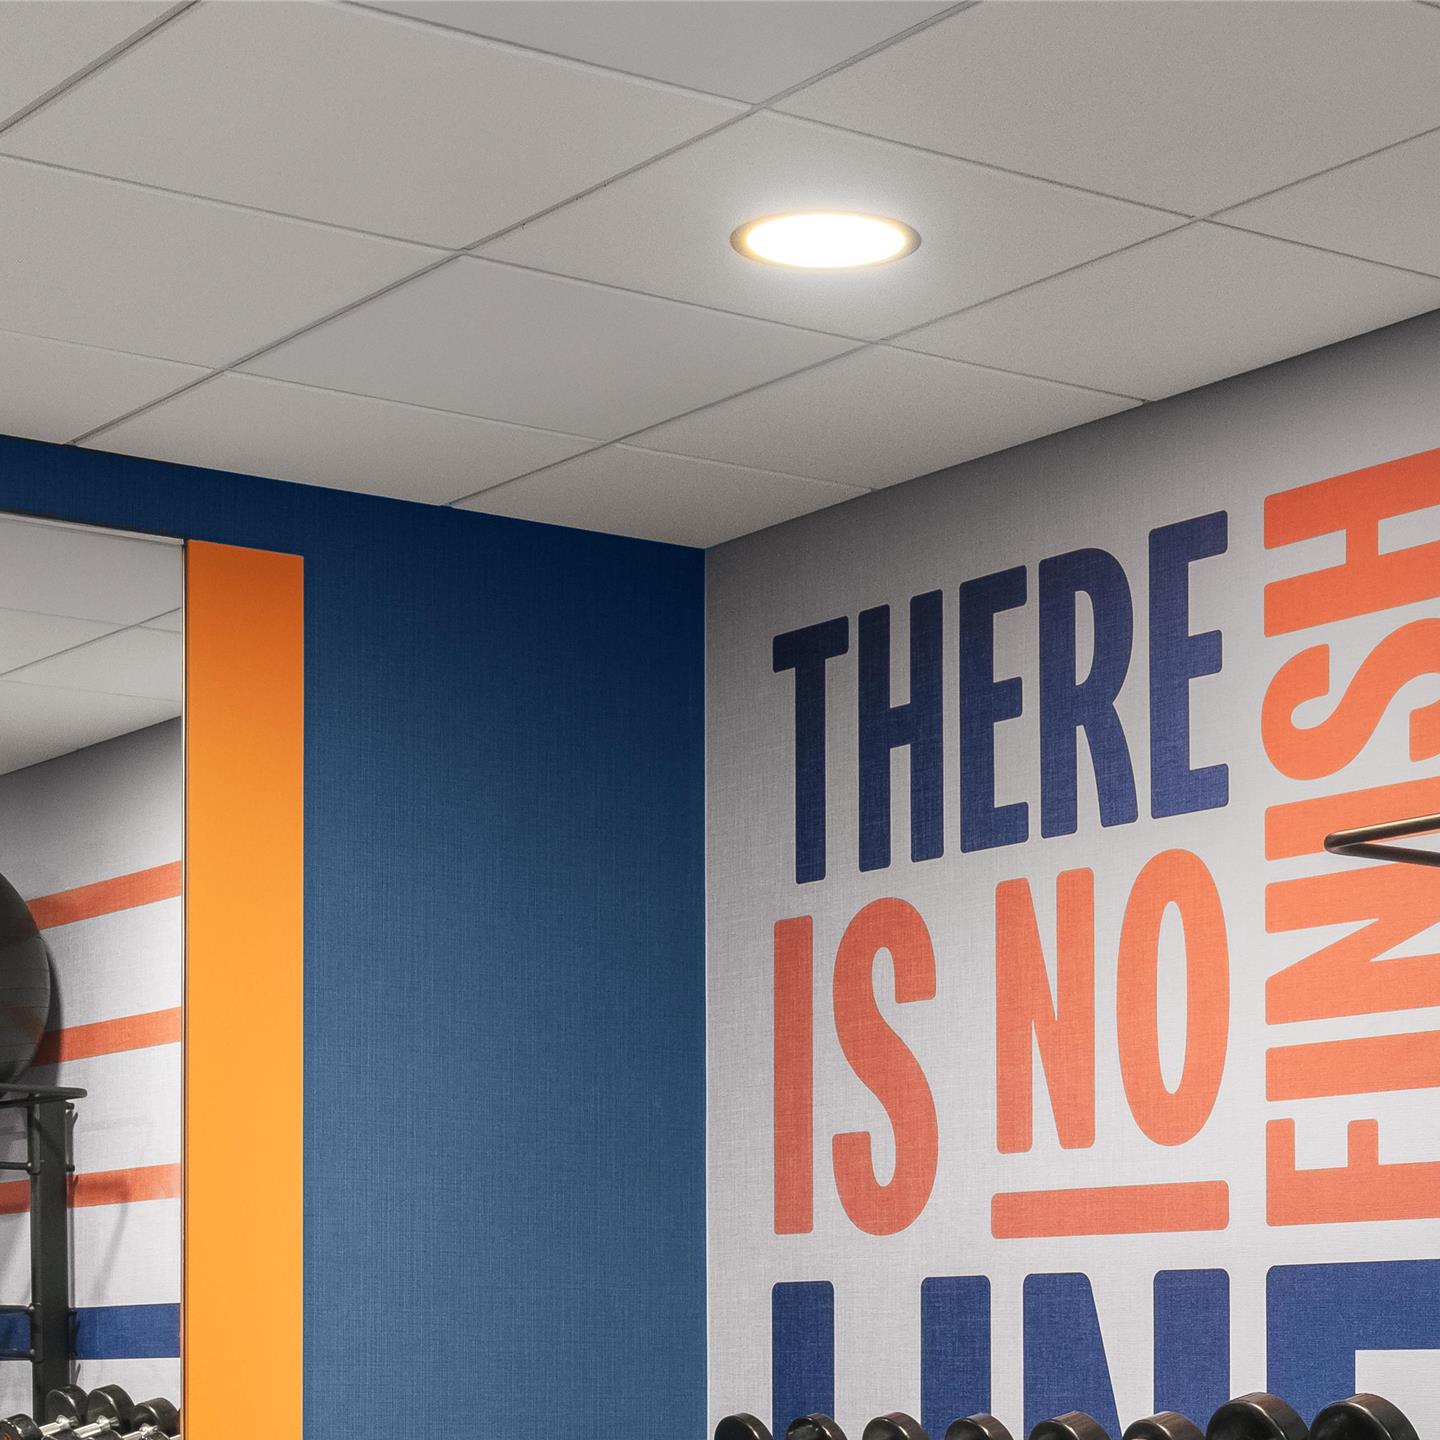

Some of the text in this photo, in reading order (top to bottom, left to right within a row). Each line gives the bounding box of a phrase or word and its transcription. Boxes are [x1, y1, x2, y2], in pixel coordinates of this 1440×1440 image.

[772, 510, 1229, 884] THERE
[773, 848, 1230, 1236] IS NO
